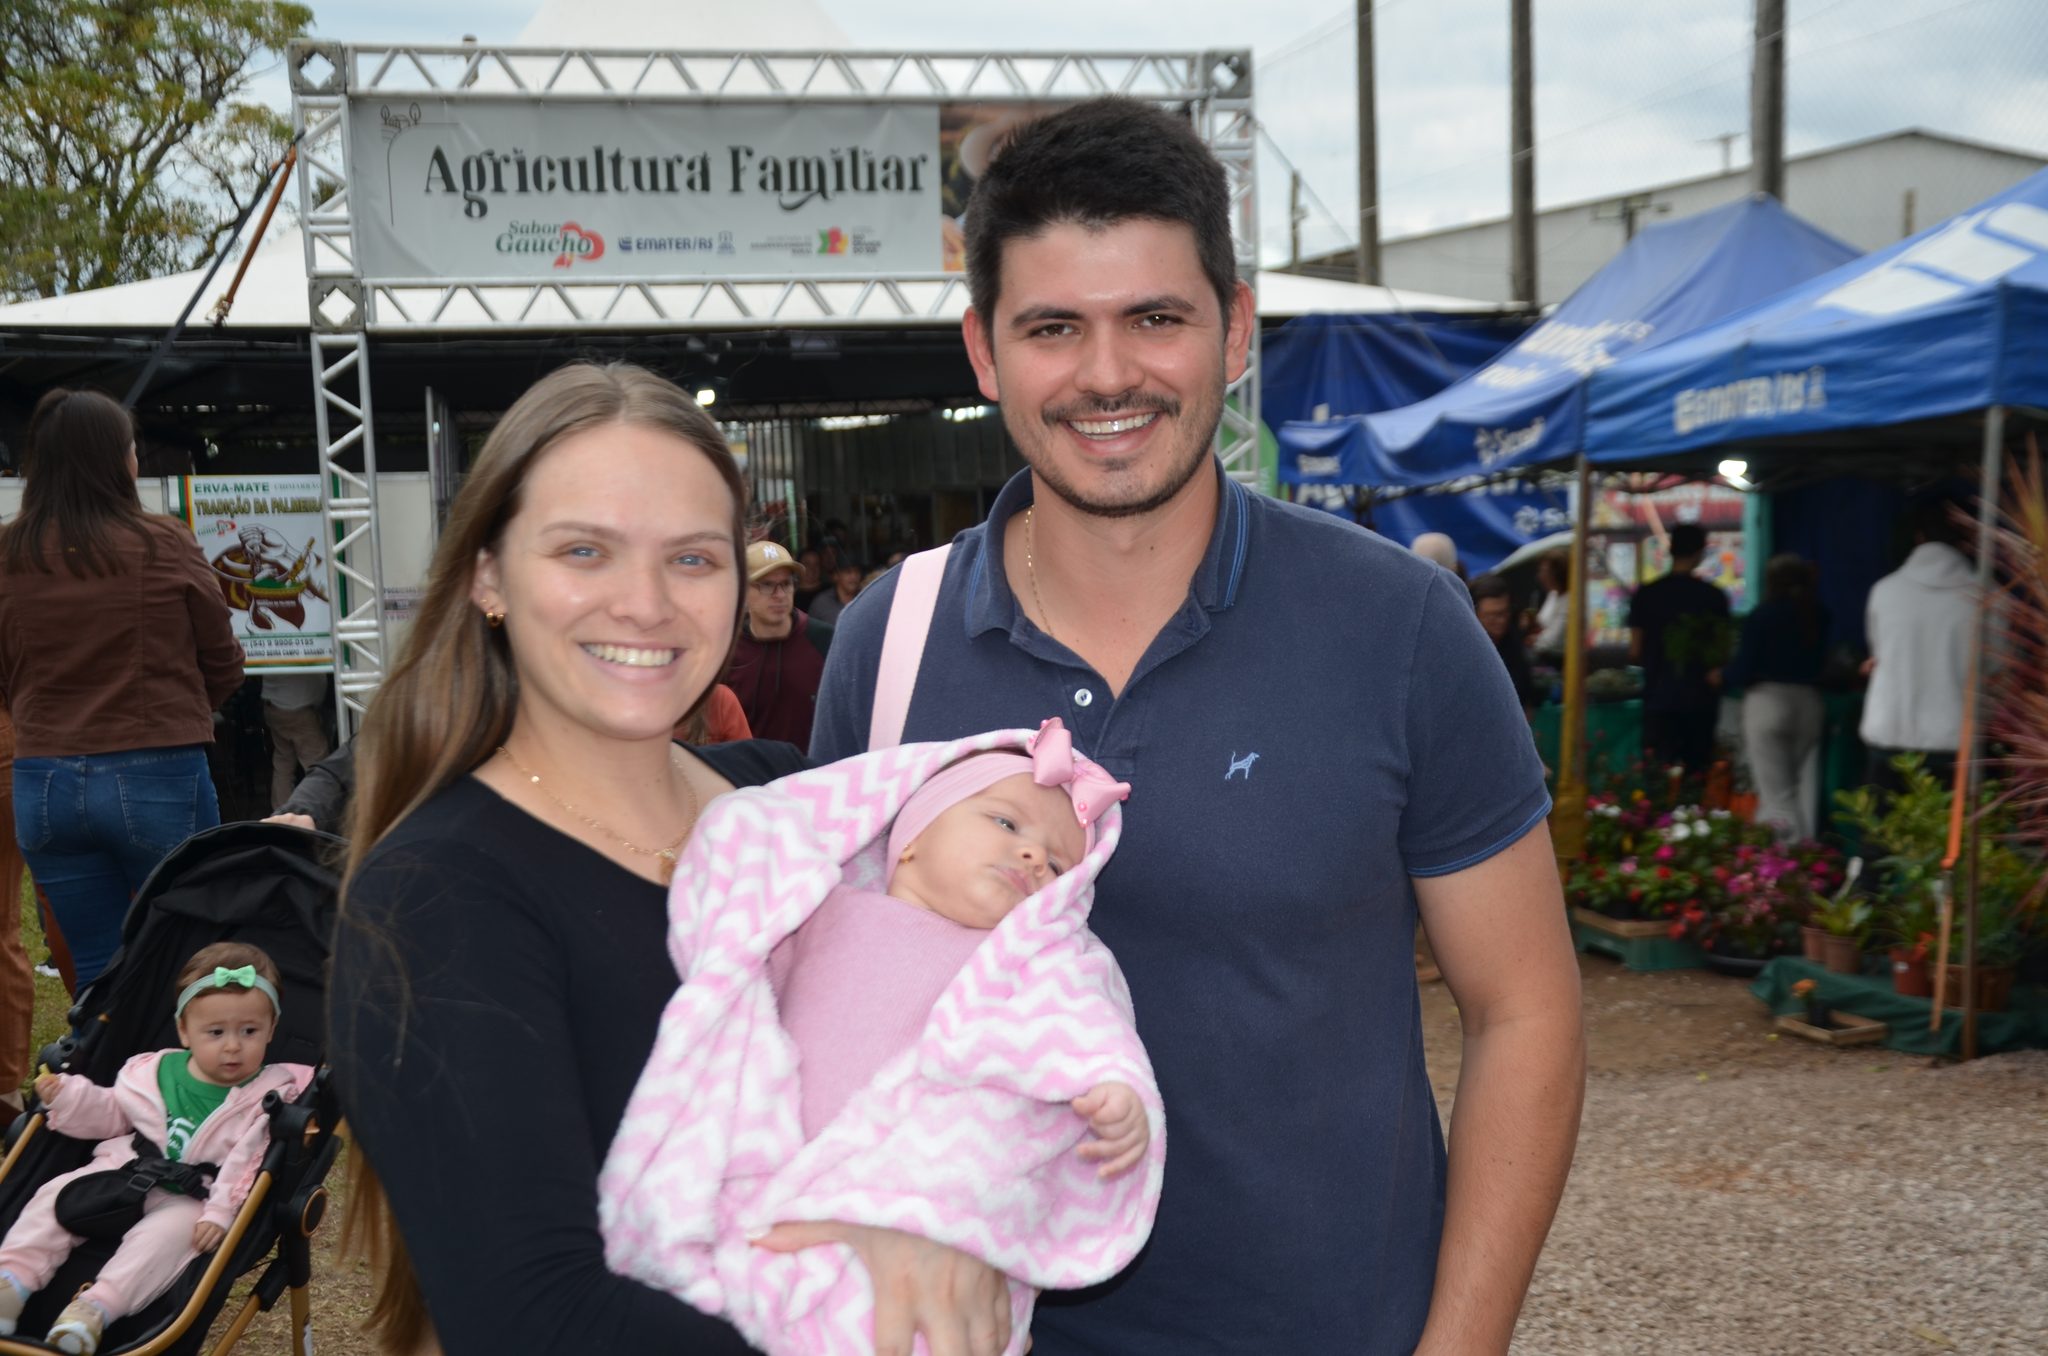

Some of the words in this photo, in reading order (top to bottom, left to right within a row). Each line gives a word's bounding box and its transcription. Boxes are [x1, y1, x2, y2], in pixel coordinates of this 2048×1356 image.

[424, 145, 712, 219] Agricultura
[728, 145, 928, 212] Familiar
[508, 219, 561, 235] Sabor
[636, 238, 713, 250] EMATER/RS
[194, 482, 270, 494] ERVA-MATE
